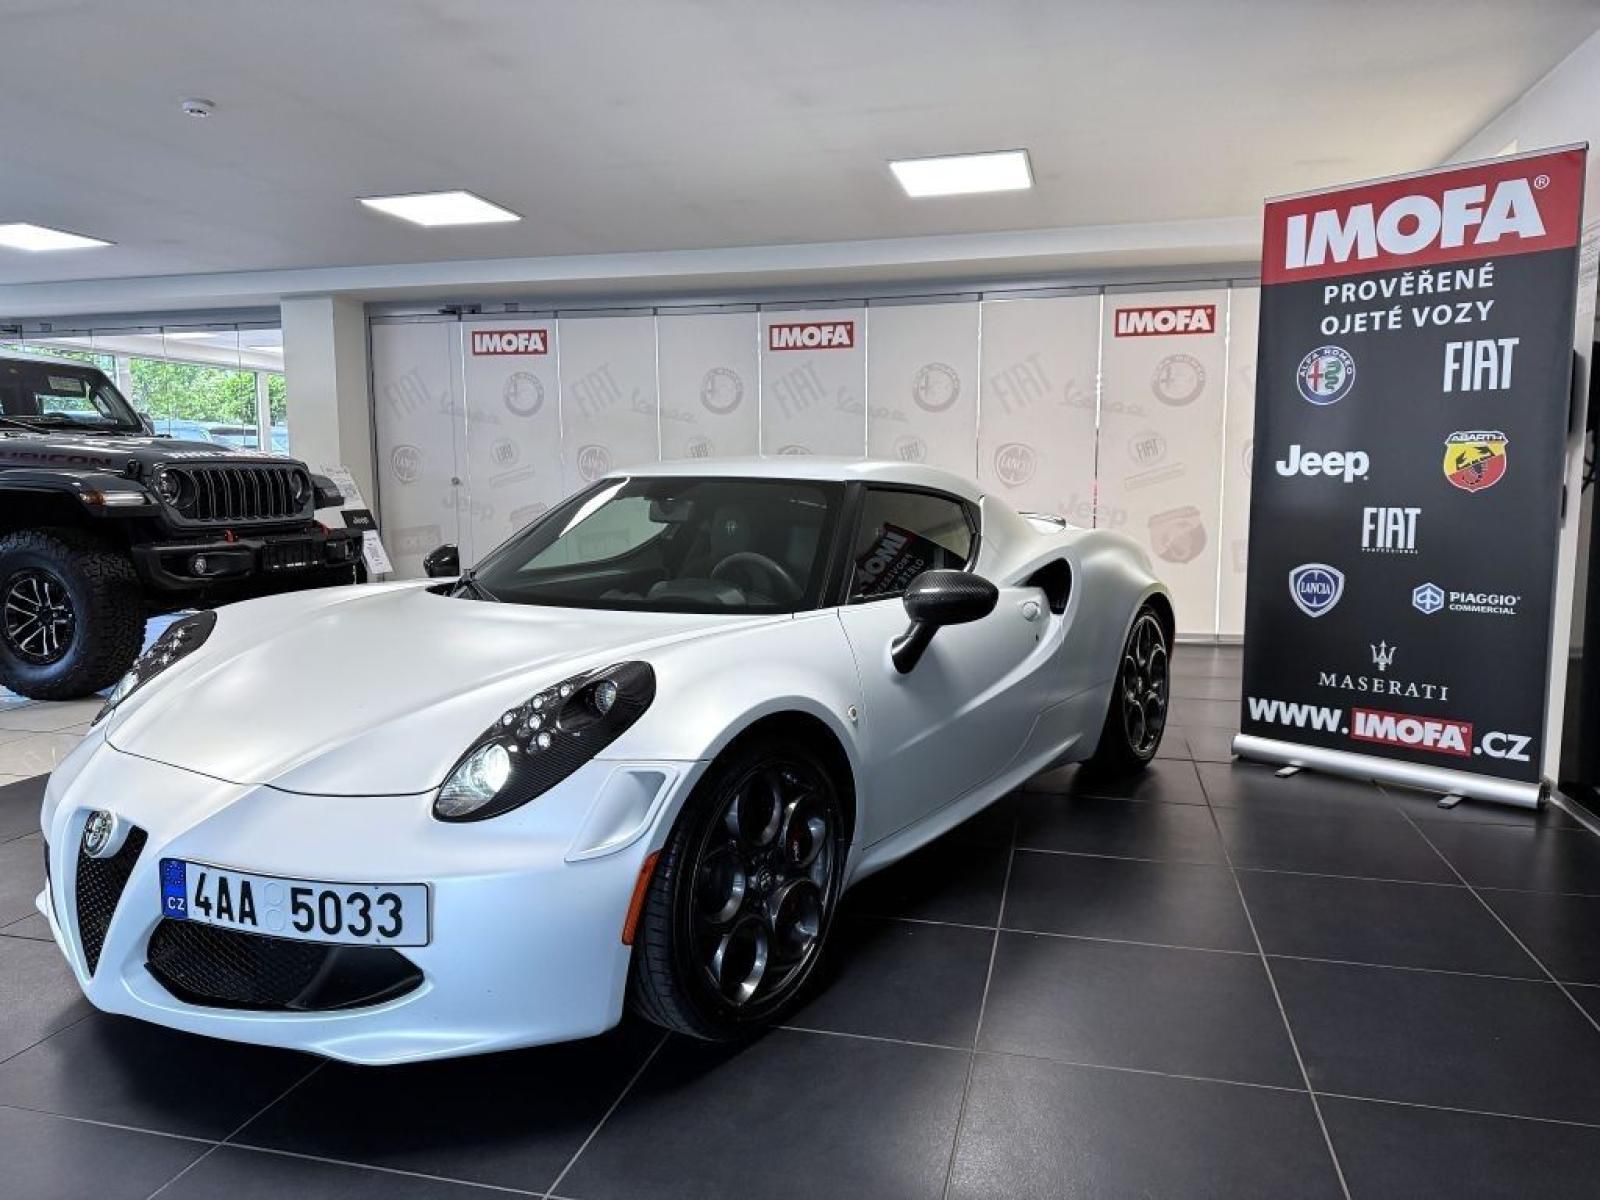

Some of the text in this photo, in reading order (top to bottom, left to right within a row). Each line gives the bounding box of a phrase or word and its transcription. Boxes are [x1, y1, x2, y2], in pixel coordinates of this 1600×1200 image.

[1324, 262, 1494, 305] PROVĚŘENÉ
[1118, 309, 1210, 334] IMOFA
[1321, 300, 1494, 336] OJETÉ VOZY
[474, 332, 544, 353] IMOFA
[772, 325, 850, 348] IMOFA
[1443, 338, 1519, 392] FIAT
[570, 362, 622, 418] FIAT
[770, 360, 828, 419] FIAT
[990, 352, 1053, 415] FIAT
[1276, 444, 1369, 482] Jeep
[1362, 507, 1421, 549] FIAT
[1300, 582, 1331, 595] LANCIA
[1449, 591, 1517, 606] PIAGGIO
[1449, 604, 1517, 615] COMMERCIAL
[1318, 672, 1449, 701] MASERATI
[167, 894, 185, 912] CZ
[194, 872, 403, 938] 4AA 5033
